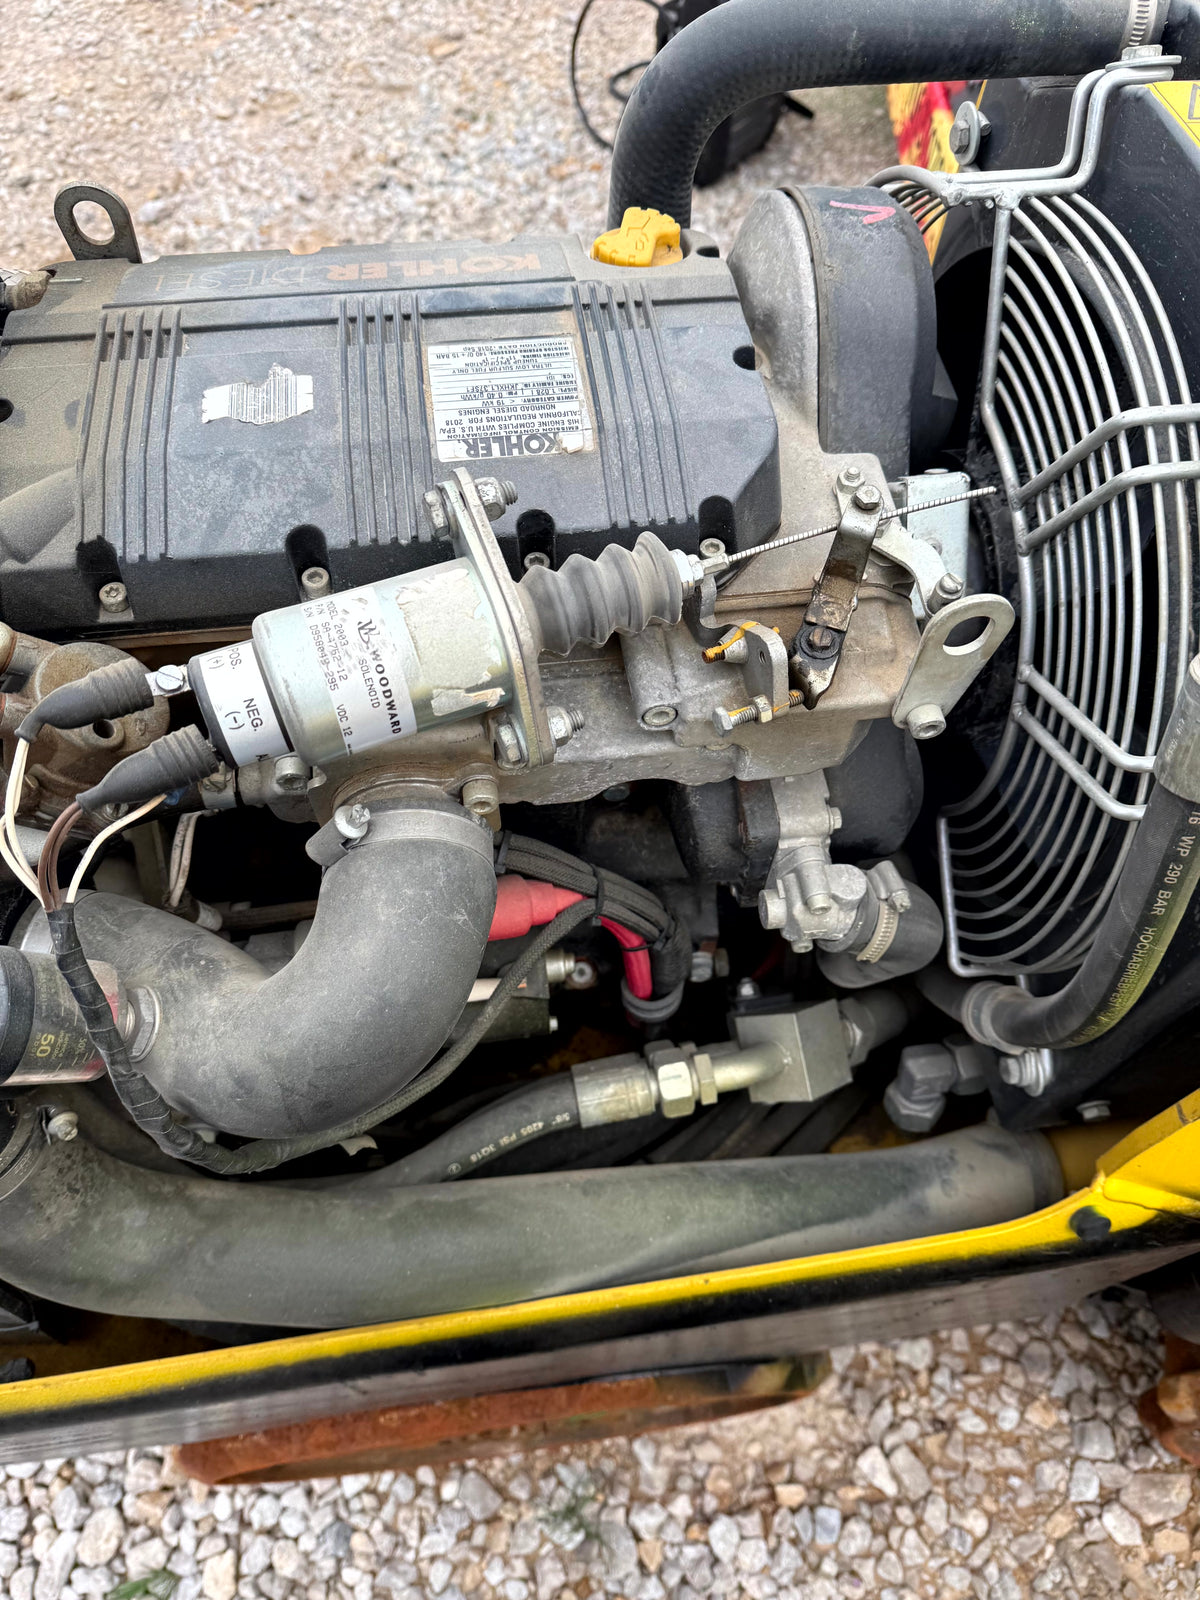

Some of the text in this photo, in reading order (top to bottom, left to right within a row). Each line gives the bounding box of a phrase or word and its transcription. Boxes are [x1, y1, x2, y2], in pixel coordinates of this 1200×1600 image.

[150, 253, 541, 293] KOHLER DIESEL
[458, 404, 556, 416] NONROAD DIESEL ENGINES
[485, 413, 537, 423] REGULATIONS
[498, 422, 535, 430] COMPLIES
[537, 420, 565, 428] ENGINE
[542, 426, 579, 434] EMISSION
[447, 431, 502, 439] INFORMATION
[326, 601, 338, 620] MODEL
[358, 659, 381, 709] SOLENOID
[373, 650, 402, 735] WOODWARD
[243, 698, 263, 732] NEG.
[336, 704, 349, 723] VDC
[343, 726, 353, 737] 12
[1176, 836, 1196, 857] WP
[1164, 862, 1183, 884] 290
[1151, 890, 1173, 915] BAR
[36, 1033, 55, 1057] 50
[520, 1121, 544, 1135] 4205
[499, 1133, 516, 1145] PSI
